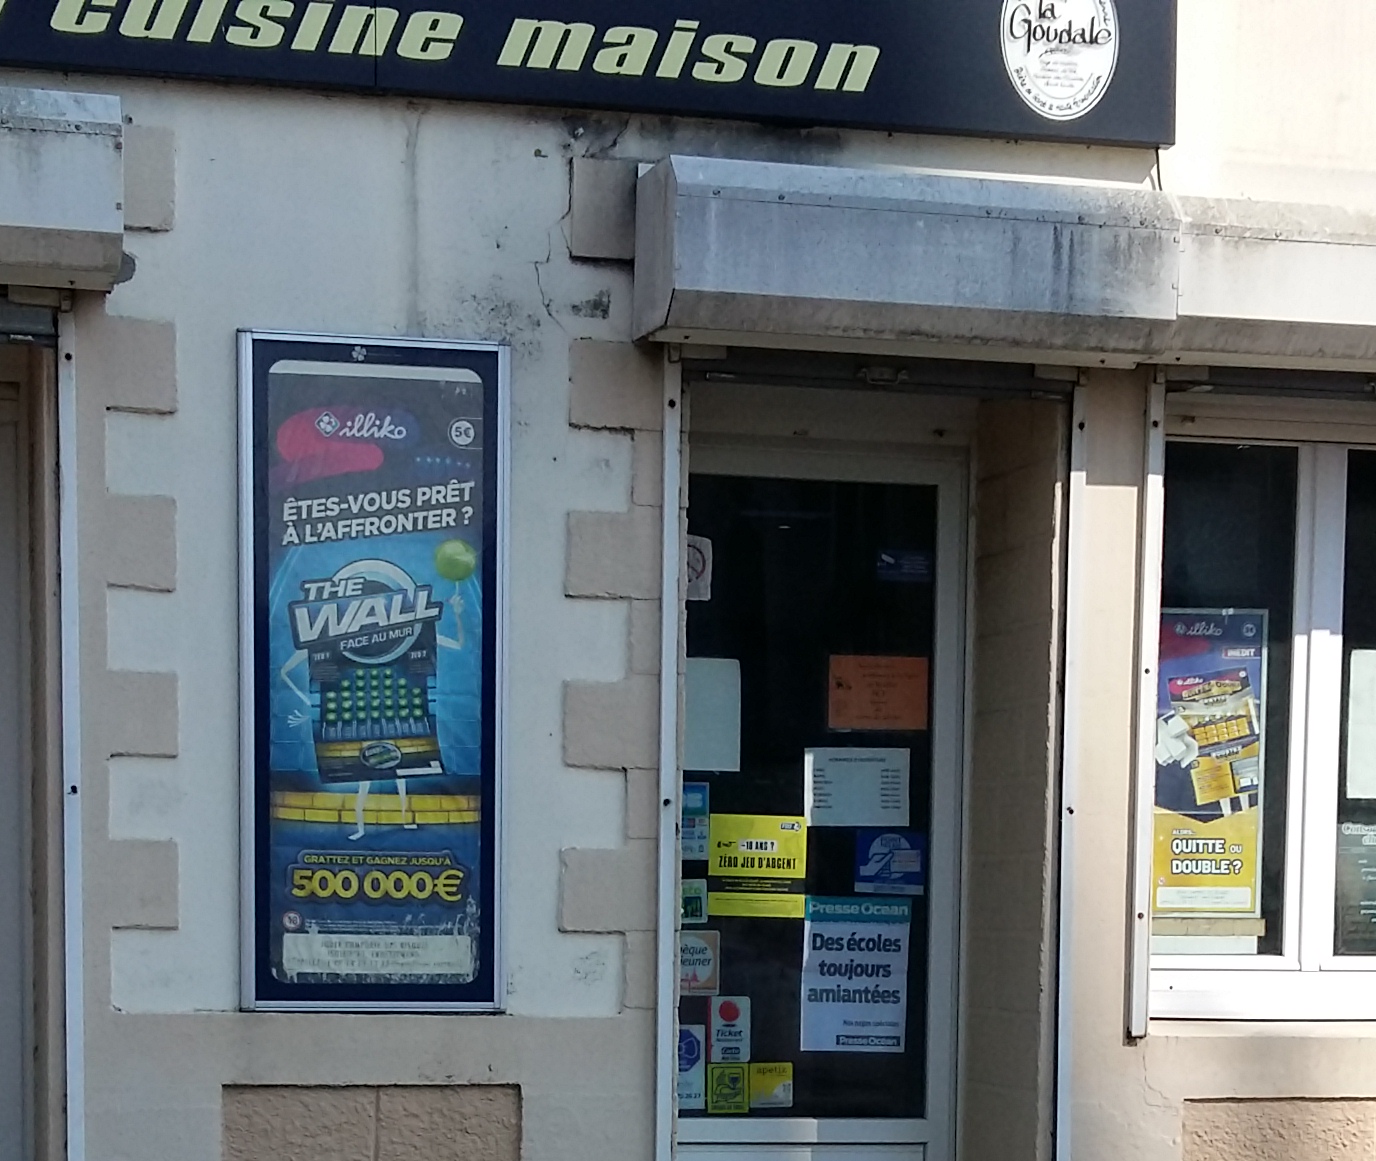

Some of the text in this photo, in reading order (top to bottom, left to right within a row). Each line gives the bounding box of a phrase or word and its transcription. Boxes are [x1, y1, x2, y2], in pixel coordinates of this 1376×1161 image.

[1009, 4, 1113, 54] Goudale
[49, 0, 464, 60] cuisine
[497, 18, 880, 92] maison
[339, 412, 407, 439] illiko
[455, 426, 472, 437] 5€
[283, 479, 475, 521] ÊTES-VOUS PRÊT
[282, 506, 474, 545] À L'AFFRONTER ?
[304, 578, 365, 601] THE
[294, 590, 440, 643] WALL
[340, 626, 413, 650] FACE AU MUR
[1186, 622, 1223, 636] illiko
[755, 842, 768, 851] ANS
[1172, 839, 1242, 854] QUITTE OU
[304, 855, 350, 865] GRATTEZ
[352, 856, 364, 865] ET
[366, 856, 408, 866] GAGNEZ
[741, 857, 755, 868] JEU
[758, 857, 796, 870] D'ARGENT
[1172, 860, 1230, 874] DOUBLE
[291, 869, 464, 902] 500 000€
[809, 901, 859, 915] Presse
[812, 932, 901, 952] Des écoles
[818, 959, 892, 981] toujours
[808, 984, 901, 1004] amiantées
[716, 1029, 743, 1037] Ticket
[839, 1036, 867, 1045] Presse
[756, 1066, 787, 1075] apetiz
